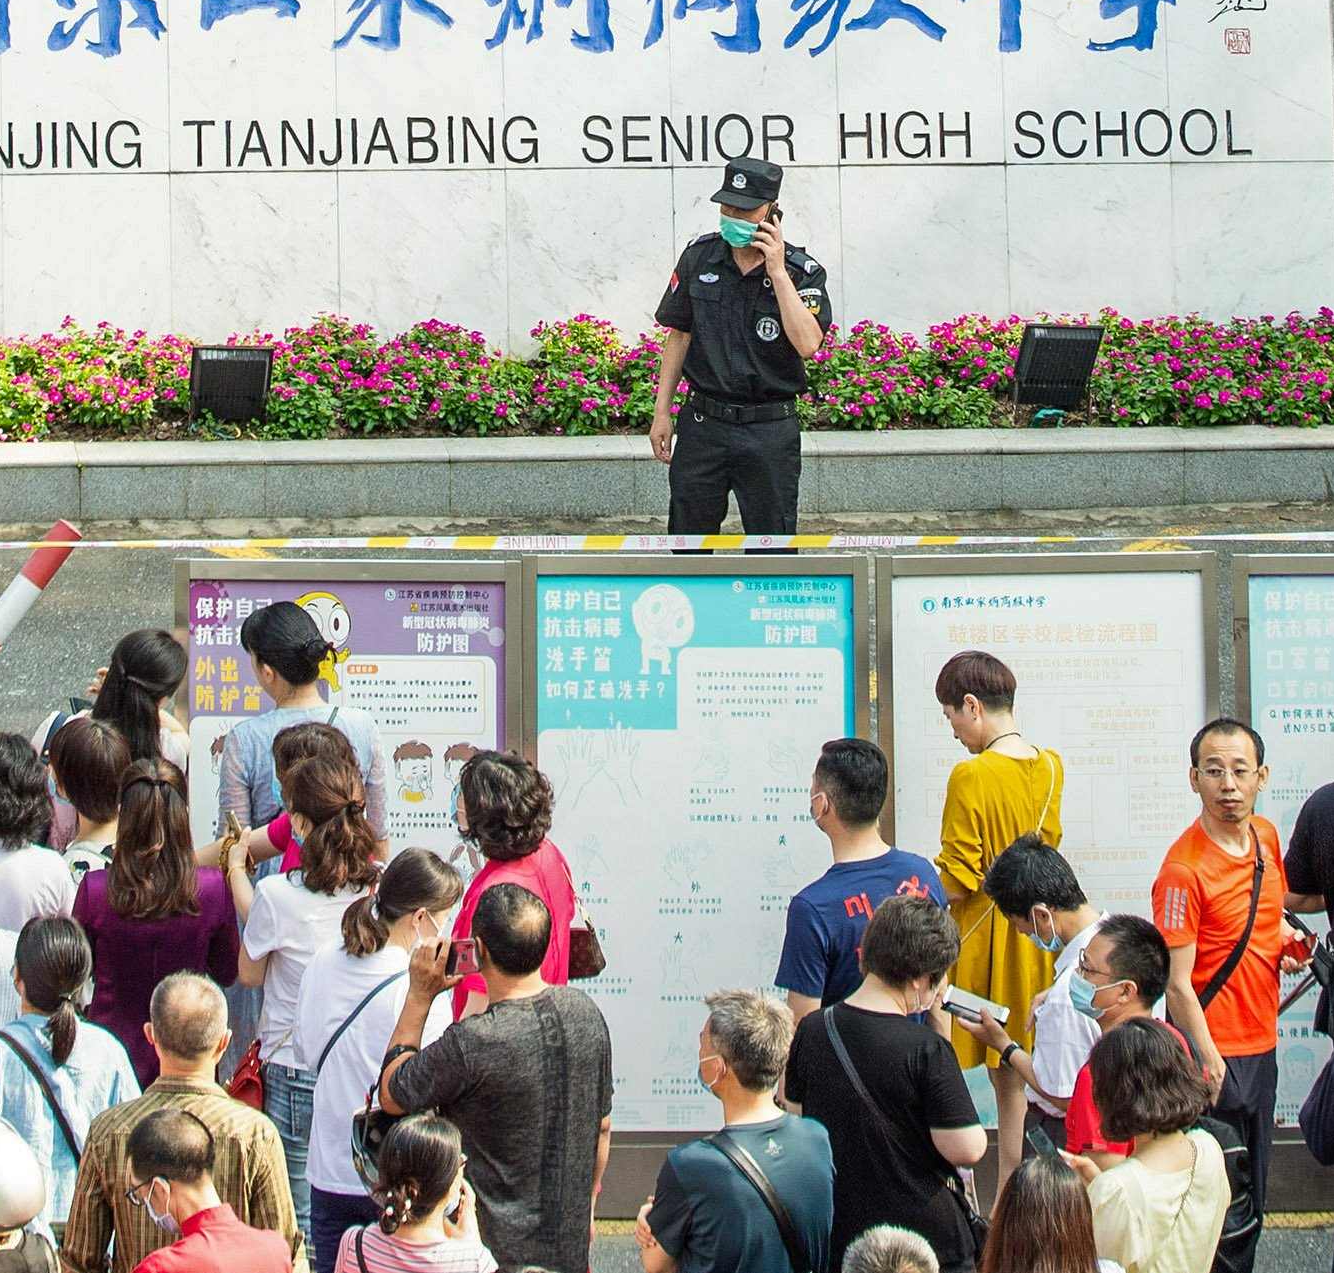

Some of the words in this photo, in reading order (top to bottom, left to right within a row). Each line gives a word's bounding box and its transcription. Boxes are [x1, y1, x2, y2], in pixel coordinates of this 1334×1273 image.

[183, 115, 540, 166] TIANJIABING
[581, 112, 796, 164] SENIOR
[839, 110, 973, 161] HIGH
[1013, 108, 1253, 159] SCHOOL
[398, 590, 489, 600] 江苏省疾病预防控制中心
[544, 590, 622, 612] 保护自己
[195, 624, 241, 647] 抗击
[544, 617, 623, 639] 抗击病毒
[764, 624, 818, 645] 防护图
[416, 633, 470, 654] 防护图
[195, 656, 239, 683] 外出
[545, 646, 612, 672] 洗手篇
[195, 685, 265, 712] 防护篇
